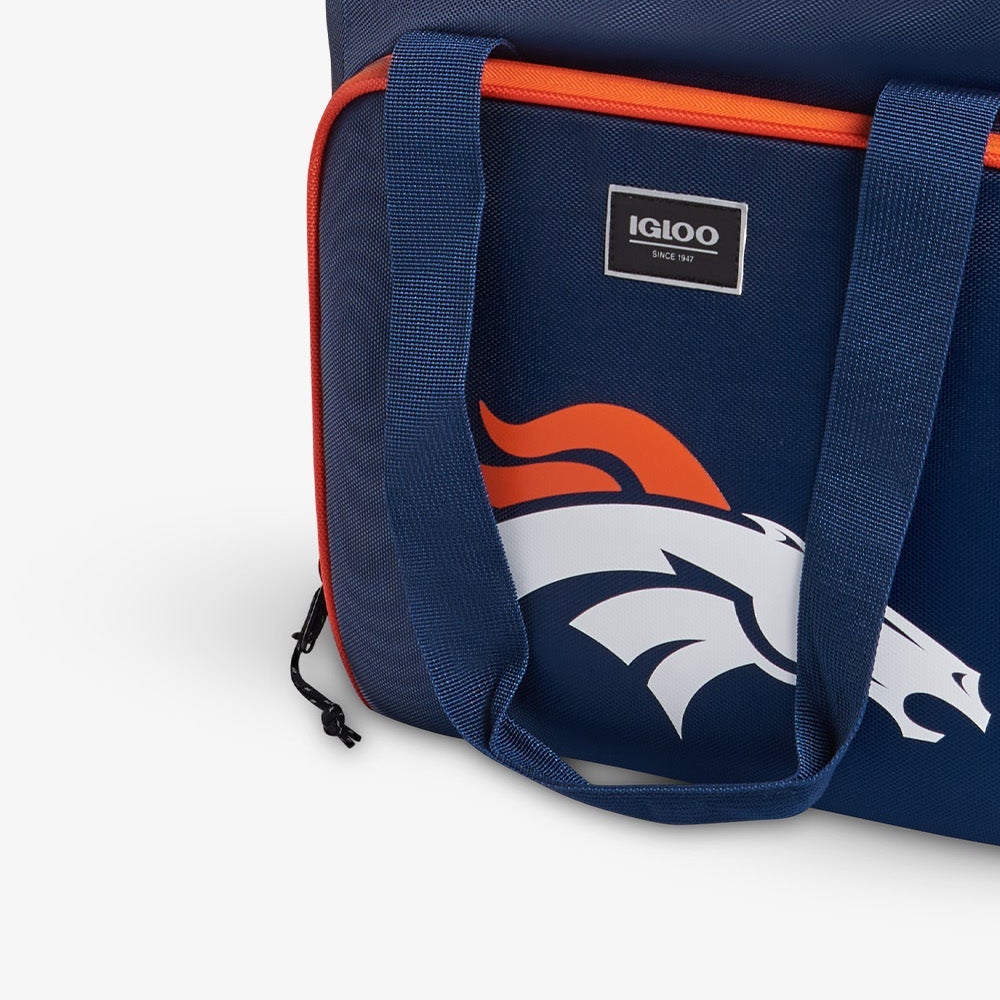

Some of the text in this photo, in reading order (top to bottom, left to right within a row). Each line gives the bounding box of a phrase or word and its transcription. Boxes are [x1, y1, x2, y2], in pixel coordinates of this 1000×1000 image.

[629, 215, 719, 246] IGLOO
[652, 250, 694, 263] SINCE 1947
